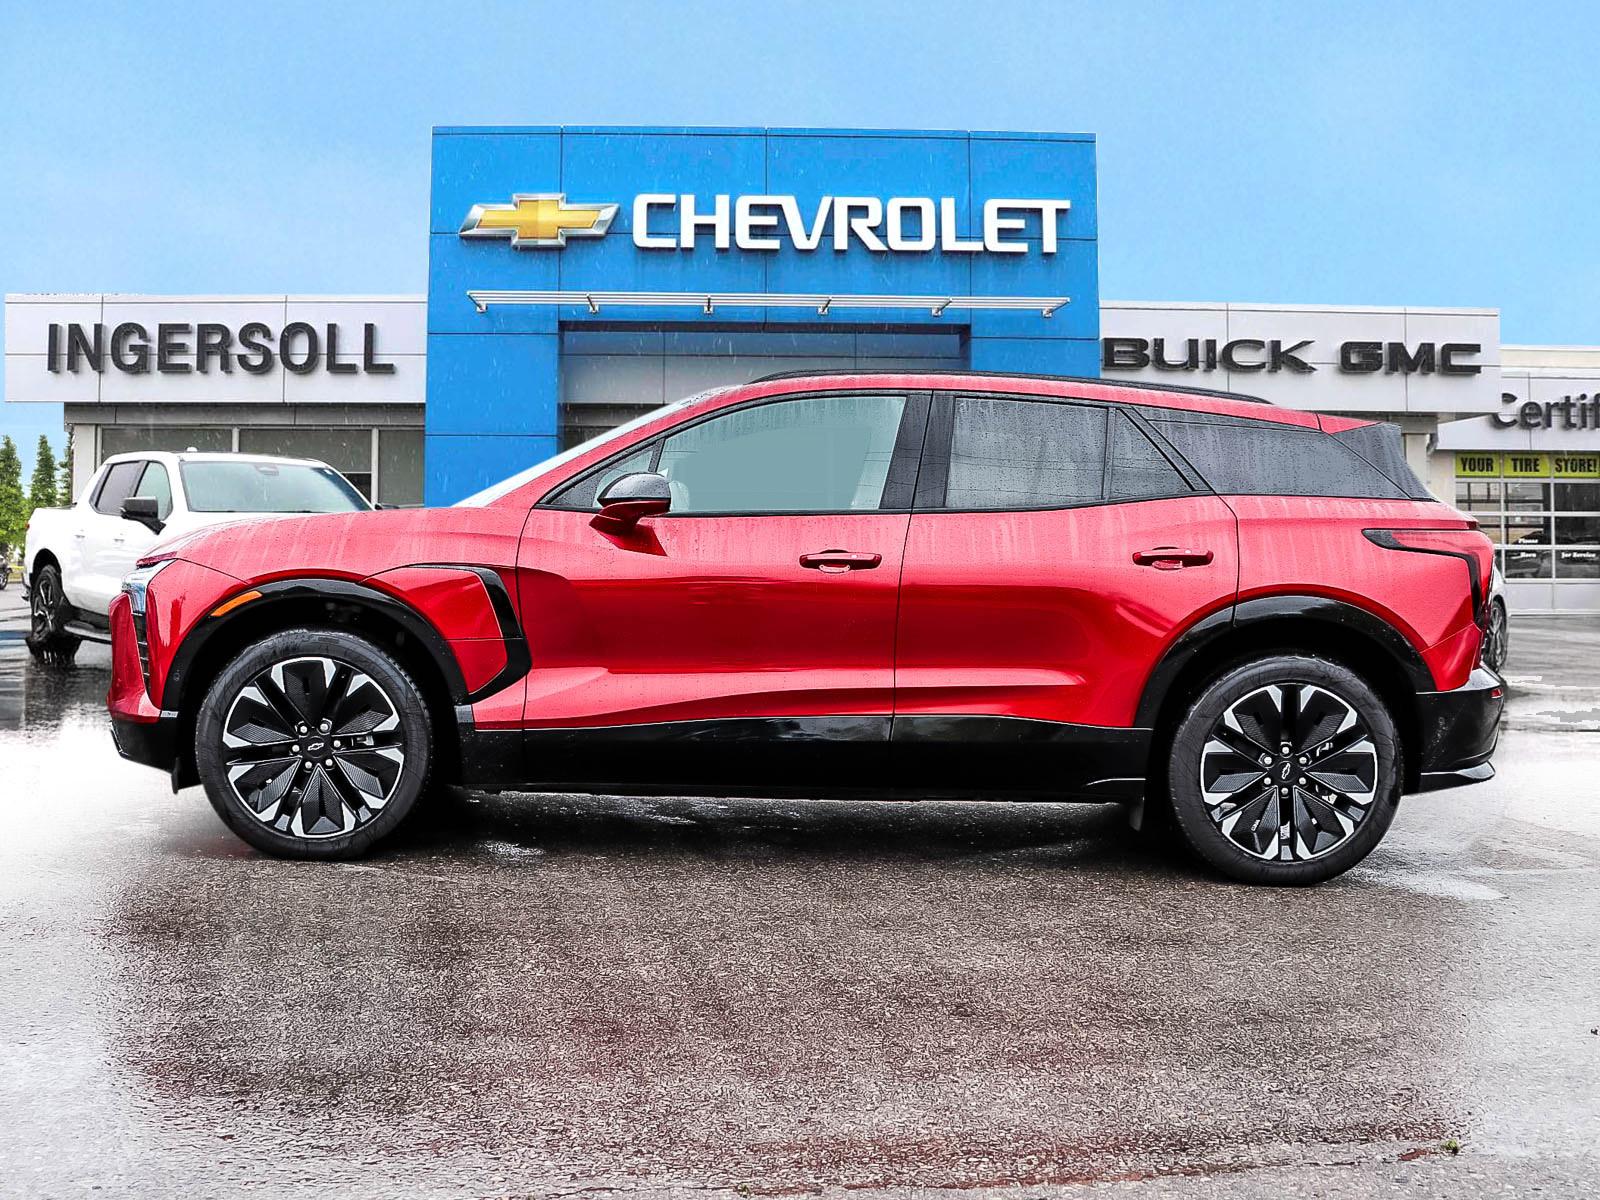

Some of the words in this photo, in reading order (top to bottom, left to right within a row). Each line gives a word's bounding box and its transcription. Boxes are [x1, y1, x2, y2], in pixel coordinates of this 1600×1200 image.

[633, 194, 1071, 253] CHEVROLET
[47, 321, 395, 374] INGERSOLL
[1101, 337, 1318, 374] BUICK
[1340, 341, 1482, 374] GMC
[1461, 457, 1494, 473] YOUR
[1511, 457, 1540, 473] TIRE
[1555, 457, 1598, 473] STORE!
